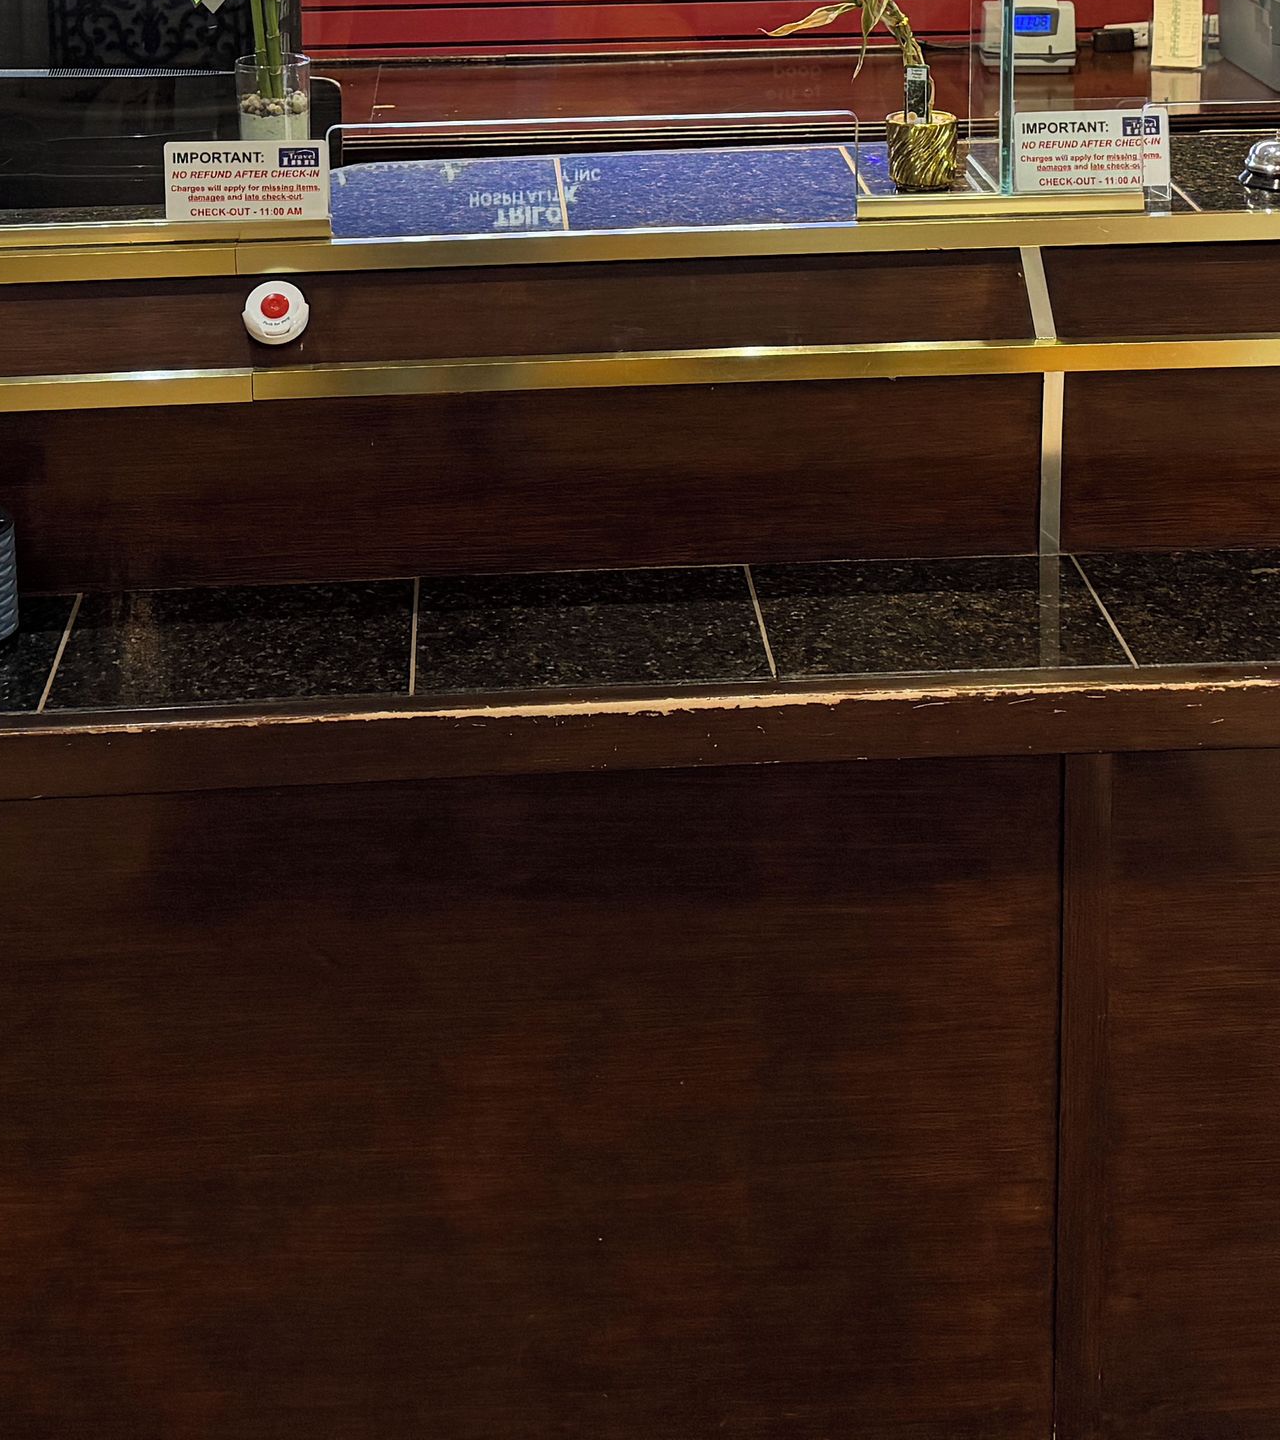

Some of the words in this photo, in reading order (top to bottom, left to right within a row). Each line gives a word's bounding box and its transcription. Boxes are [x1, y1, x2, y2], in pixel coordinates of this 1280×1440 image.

[1022, 121, 1109, 134] IMPORTANT:
[1022, 141, 1036, 149] NO
[1039, 140, 1078, 149] REFUND
[1080, 139, 1112, 148] AFTER
[1116, 137, 1161, 147] CHECK-IN
[172, 151, 264, 163] IMPORTANT:
[288, 149, 315, 159] Travel
[1021, 154, 1053, 163] Charges
[1055, 154, 1069, 162] will
[1071, 154, 1091, 162] apply
[1093, 153, 1104, 161] for
[1107, 153, 1136, 161] missing
[283, 156, 315, 166] Inn
[172, 171, 187, 179] NO
[190, 170, 231, 179] REFUND
[234, 170, 268, 178] AFTER
[271, 170, 320, 178] CHECK-IN
[1039, 177, 1096, 187] CHECK-OUT
[1105, 176, 1129, 185] 11:00
[171, 185, 205, 193] Charges
[208, 184, 221, 192] will
[224, 185, 246, 193] apply
[262, 184, 294, 192] missing
[188, 194, 225, 202] damages
[262, 193, 303, 201] check-out.
[190, 208, 251, 217] CHECK-OUT
[260, 207, 284, 216] 11:00
[287, 207, 302, 215] AM
